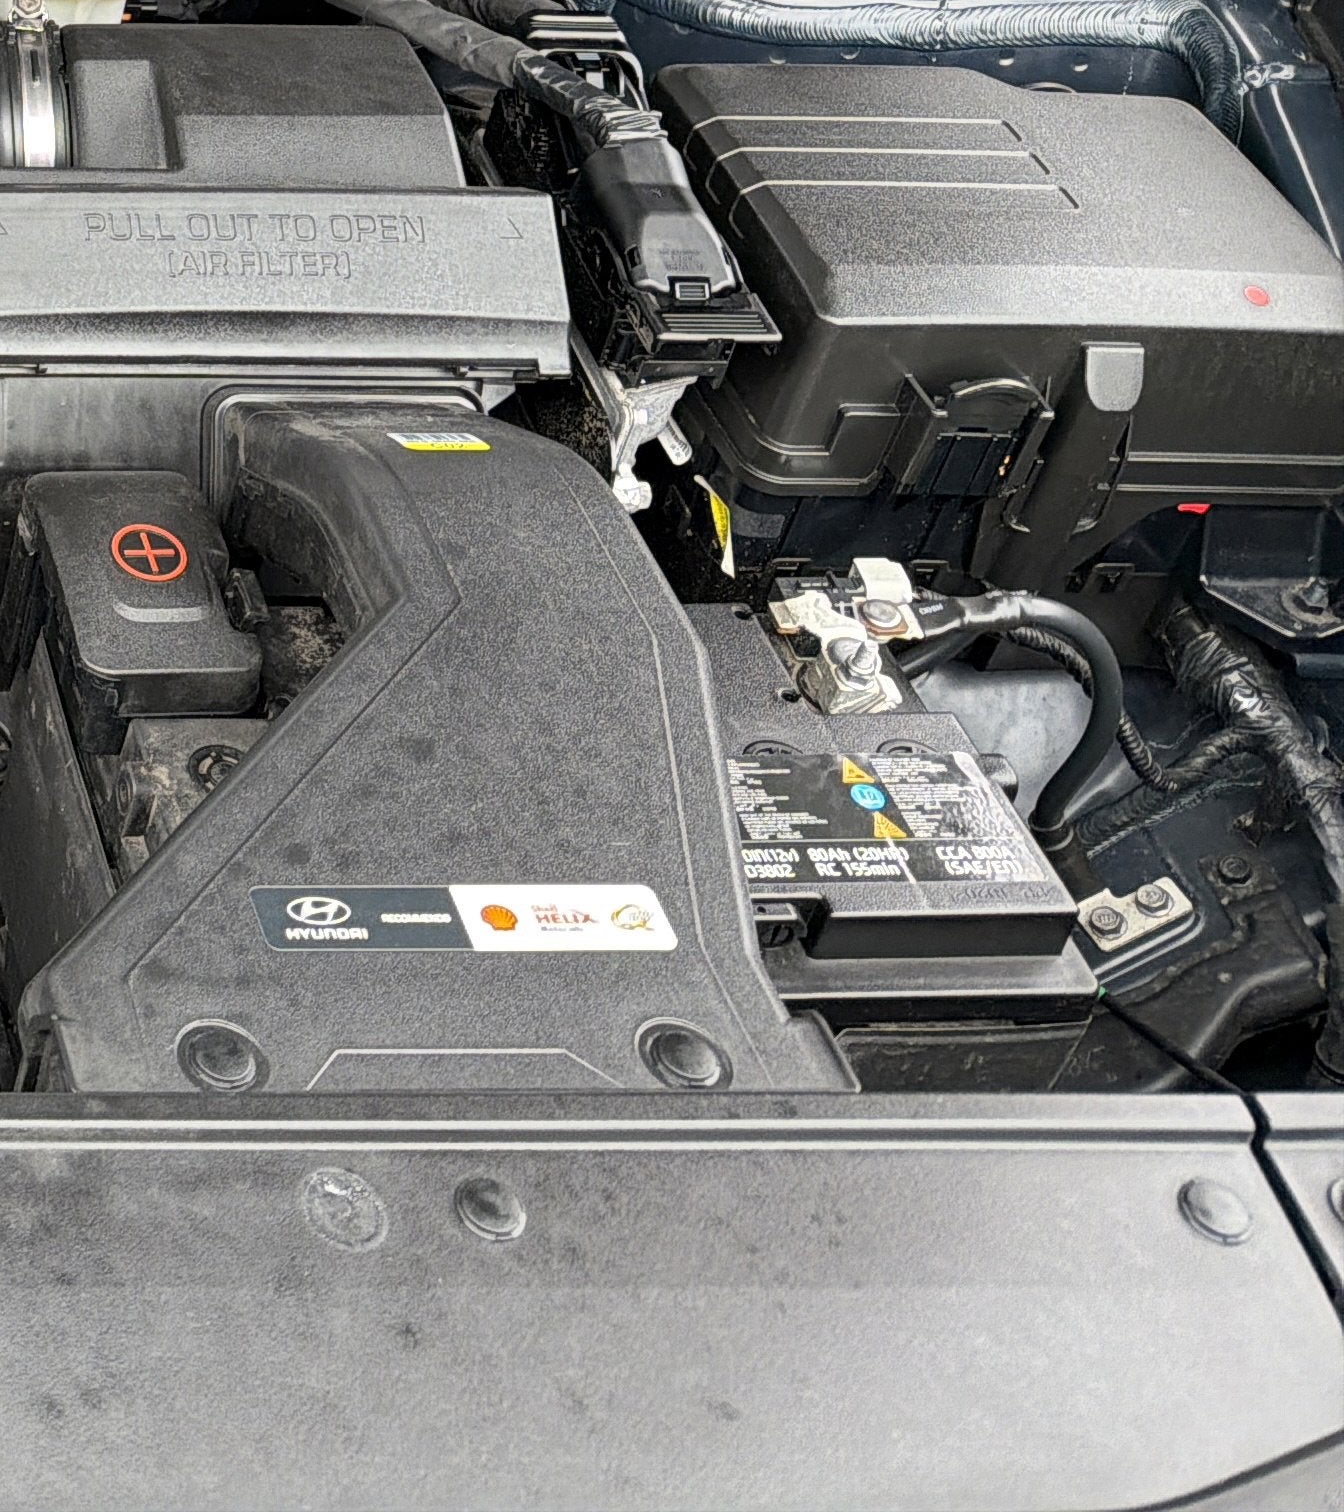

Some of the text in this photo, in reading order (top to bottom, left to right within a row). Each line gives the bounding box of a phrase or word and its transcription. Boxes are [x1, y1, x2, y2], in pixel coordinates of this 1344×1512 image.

[82, 212, 426, 243] PULL OUT TO OPEN
[935, 846, 973, 860] CCA
[814, 862, 842, 877] RC
[535, 911, 599, 924] HELIX
[285, 926, 370, 941] HYUNDAI
